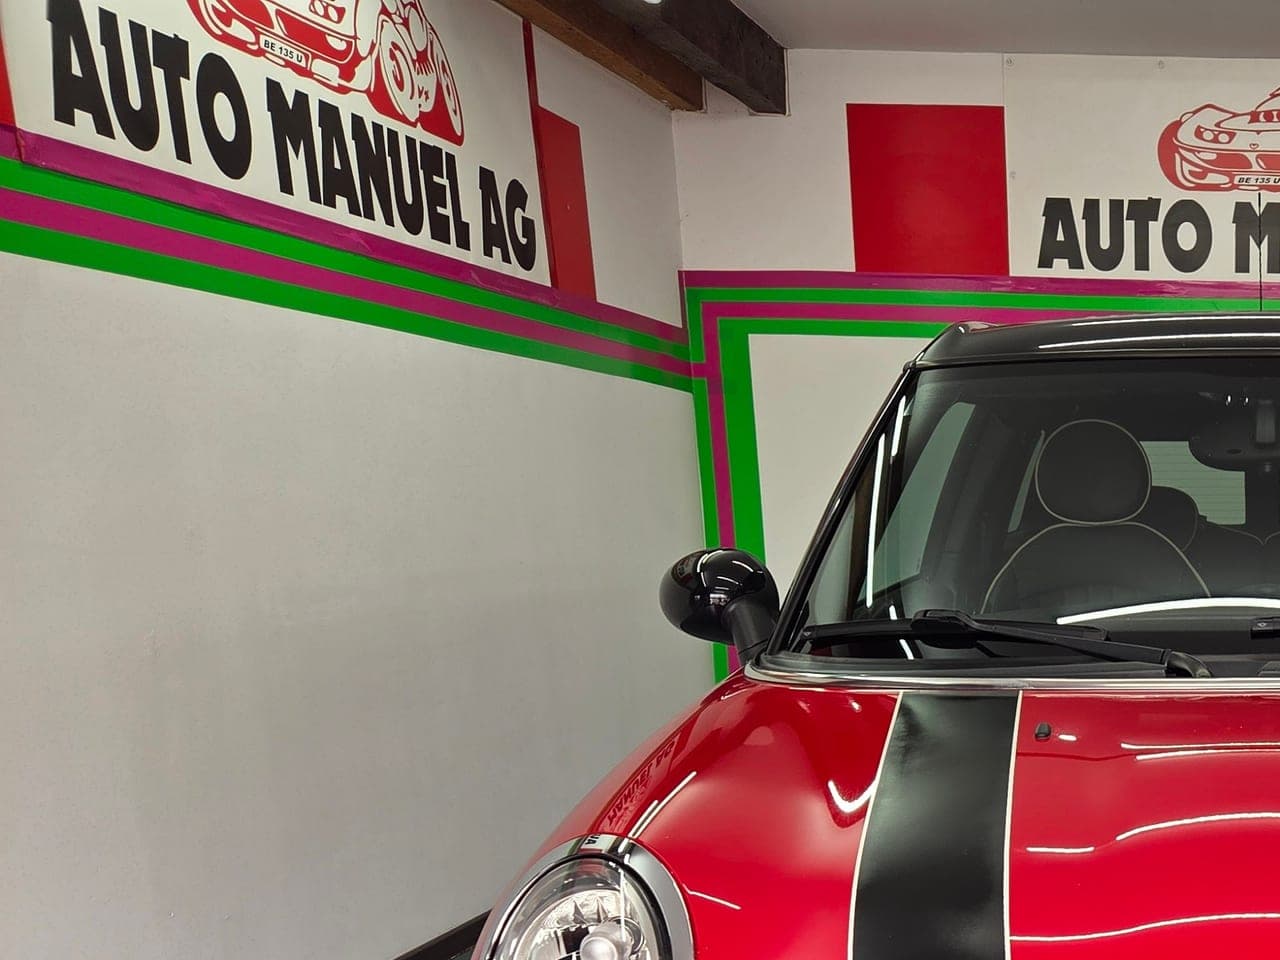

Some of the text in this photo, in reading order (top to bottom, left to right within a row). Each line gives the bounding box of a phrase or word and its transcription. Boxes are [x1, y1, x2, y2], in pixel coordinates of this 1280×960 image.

[263, 39, 303, 63] BE 135 U
[47, 0, 537, 272] AUTO MANUEL AG
[1037, 196, 1213, 273] AUTO
